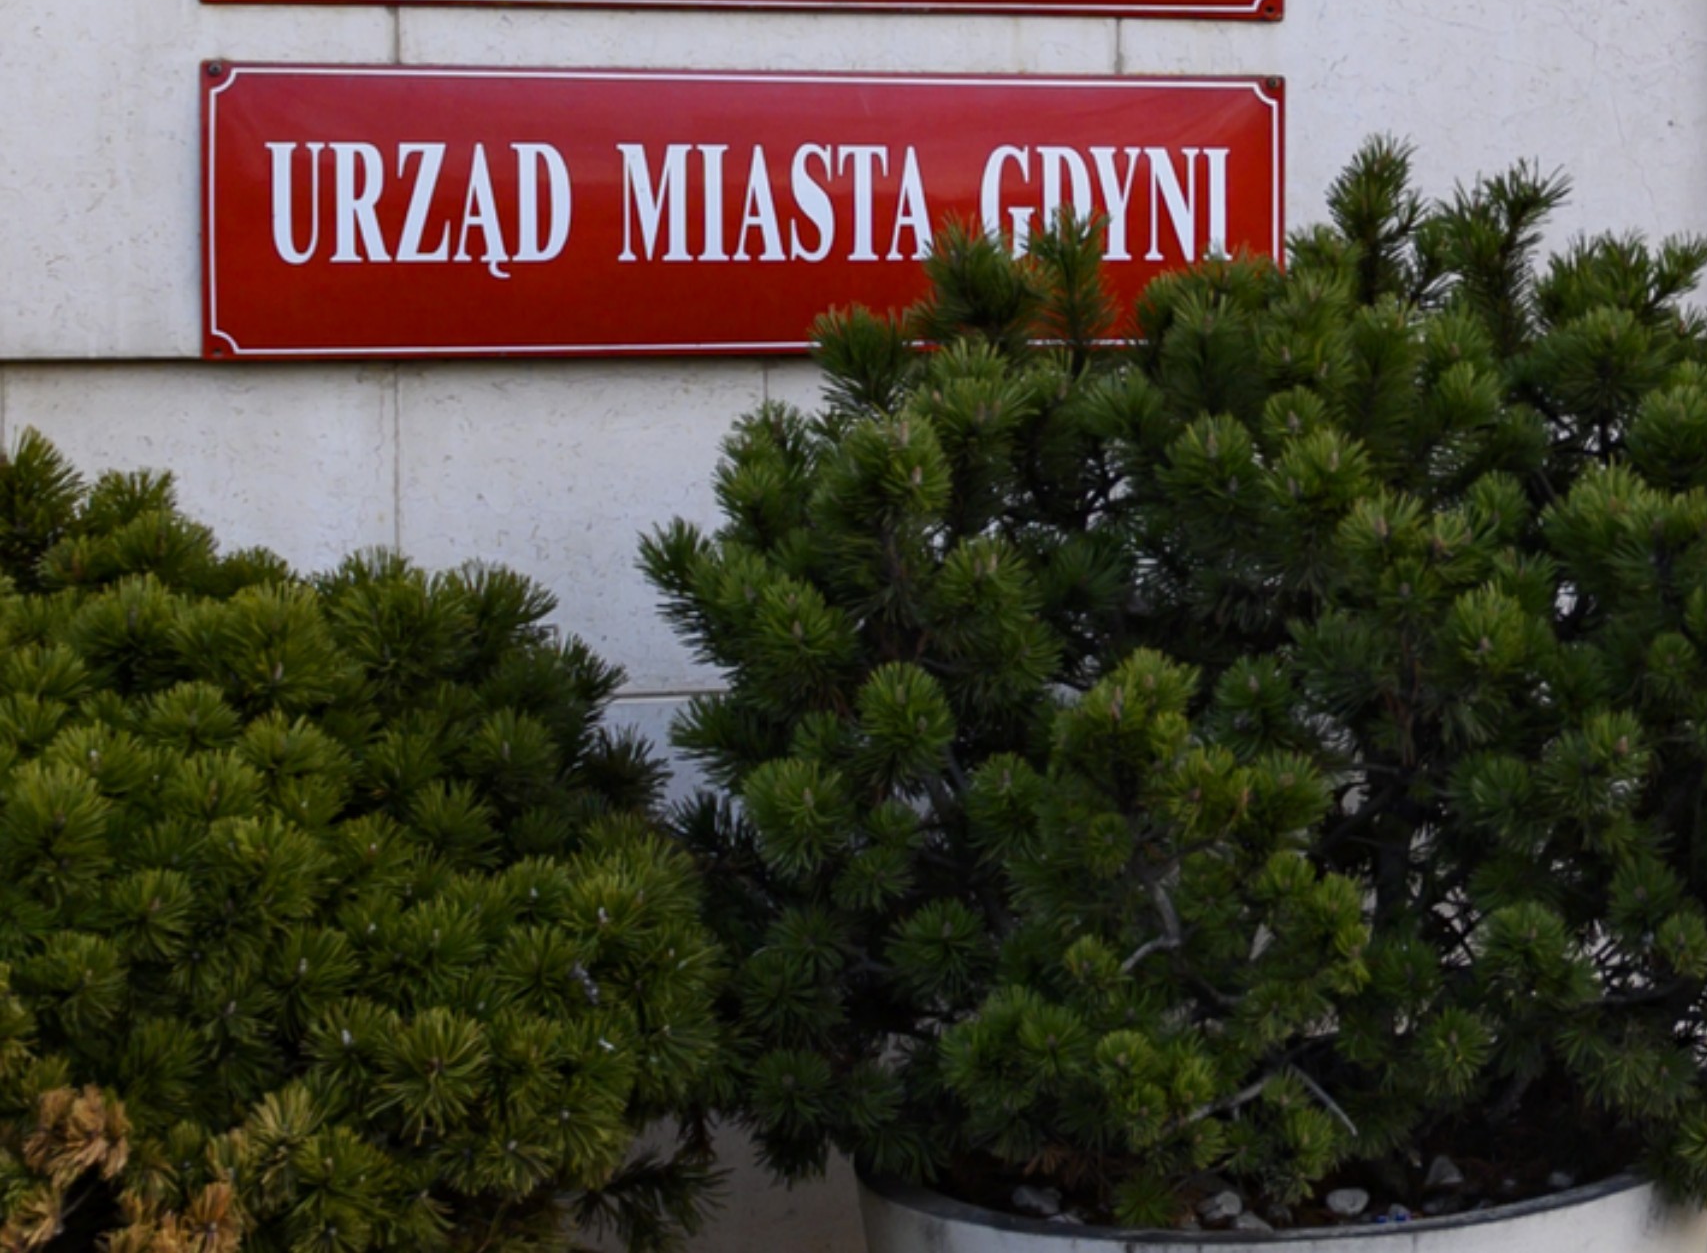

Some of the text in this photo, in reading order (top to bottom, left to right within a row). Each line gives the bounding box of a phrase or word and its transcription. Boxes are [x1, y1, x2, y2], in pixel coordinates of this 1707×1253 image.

[265, 142, 1233, 278] URZĄD MIASTA GDYNI
